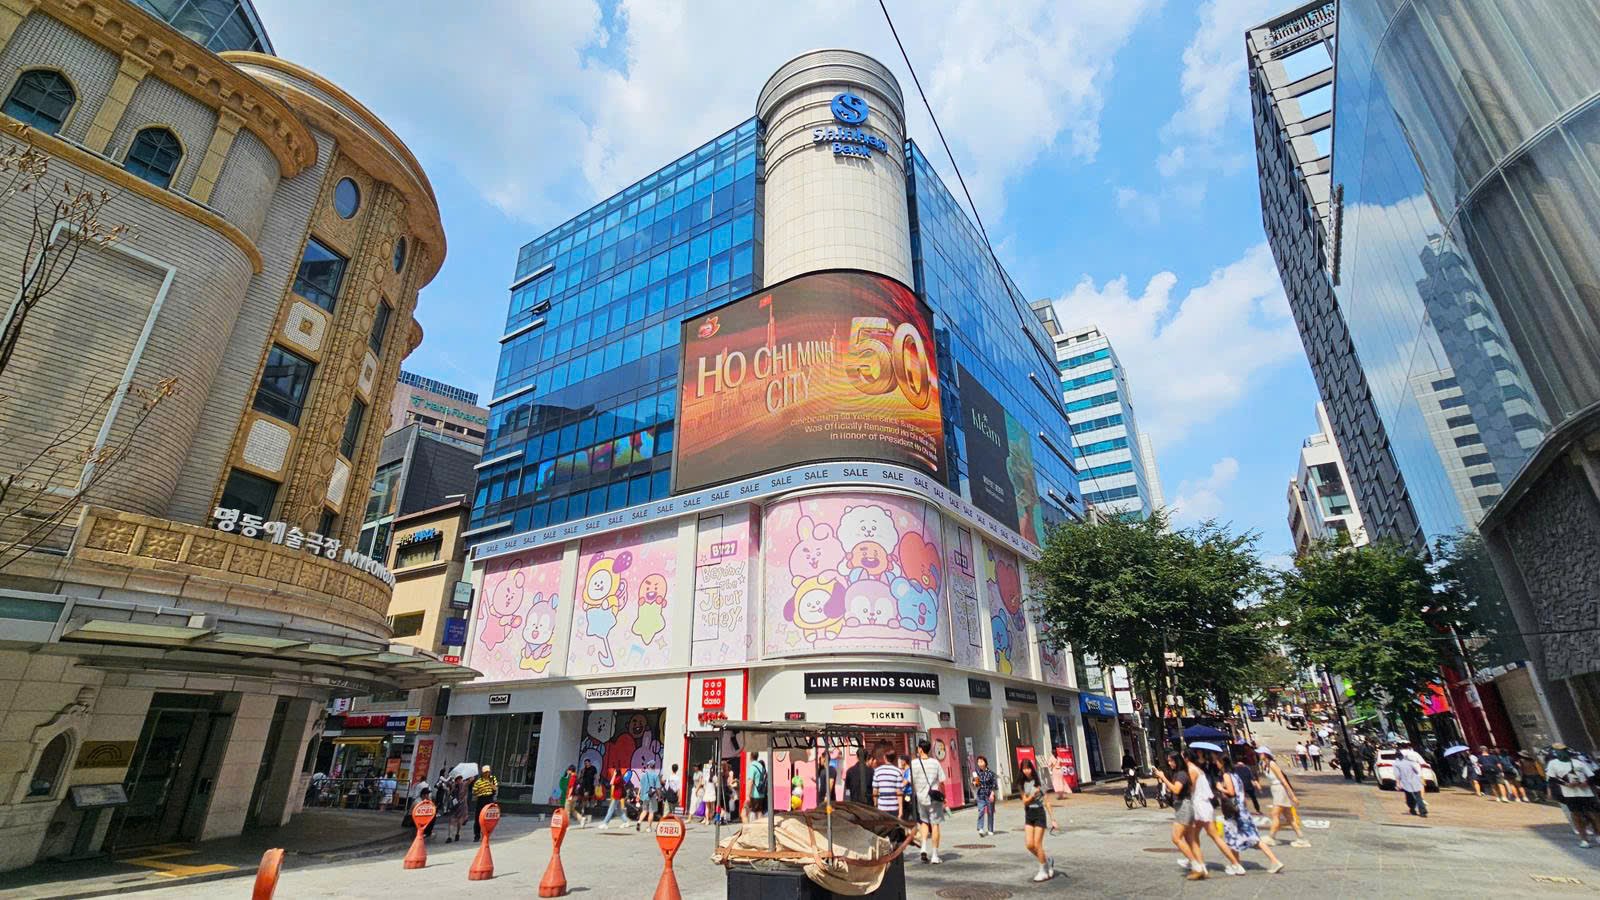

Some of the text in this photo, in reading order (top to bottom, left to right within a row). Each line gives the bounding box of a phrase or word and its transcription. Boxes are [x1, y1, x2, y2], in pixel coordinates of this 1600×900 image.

[813, 126, 888, 154] Shinhan
[832, 142, 871, 158] Bank
[697, 340, 833, 398] HO CHI MINH
[846, 317, 931, 410] 50
[765, 368, 812, 416] CITY
[805, 424, 823, 433] Was
[523, 536, 536, 544] SALE
[544, 531, 556, 539] SALE
[564, 526, 577, 535] SALE
[585, 521, 600, 530] SALE
[608, 515, 623, 525] SALE
[632, 509, 648, 519] SALE
[657, 504, 674, 514] SALE
[683, 498, 701, 508] SALE
[711, 491, 729, 501] SALE
[740, 482, 760, 494] SALE
[771, 476, 792, 488] SALE
[805, 470, 828, 480] SALE
[844, 468, 868, 476] SALE
[882, 470, 904, 481] SALE
[914, 477, 928, 490] SALE
[934, 488, 944, 500] SALE
[949, 497, 959, 508] SALE
[214, 506, 341, 559] 명동예술극장
[712, 542, 737, 555] BT21
[702, 561, 745, 583] Behind
[588, 688, 620, 697] UNIVERSTAR
[810, 677, 936, 689] LINE FRIENDS SQUARE
